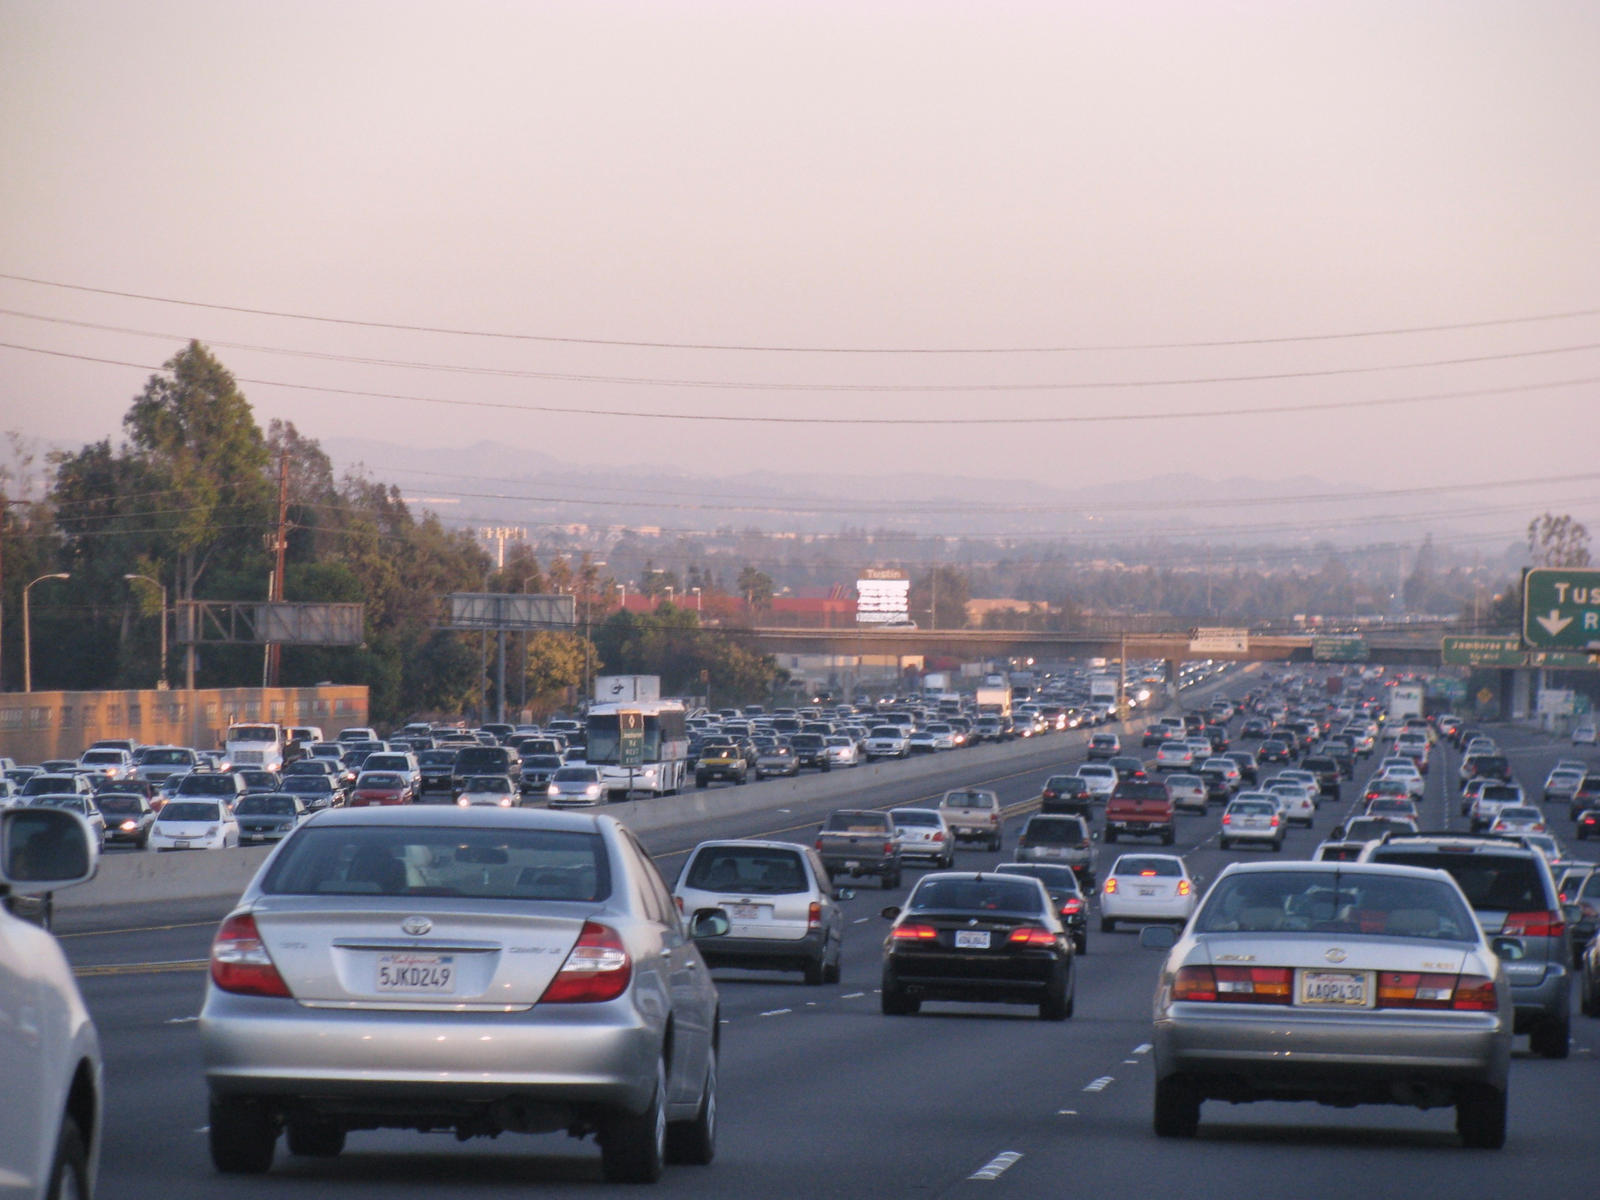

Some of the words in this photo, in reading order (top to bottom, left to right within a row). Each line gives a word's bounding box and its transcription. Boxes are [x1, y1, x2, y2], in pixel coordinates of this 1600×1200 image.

[866, 569, 901, 579] Tustin
[1394, 691, 1419, 700] FedEx
[381, 966, 451, 987] 5JKD249
